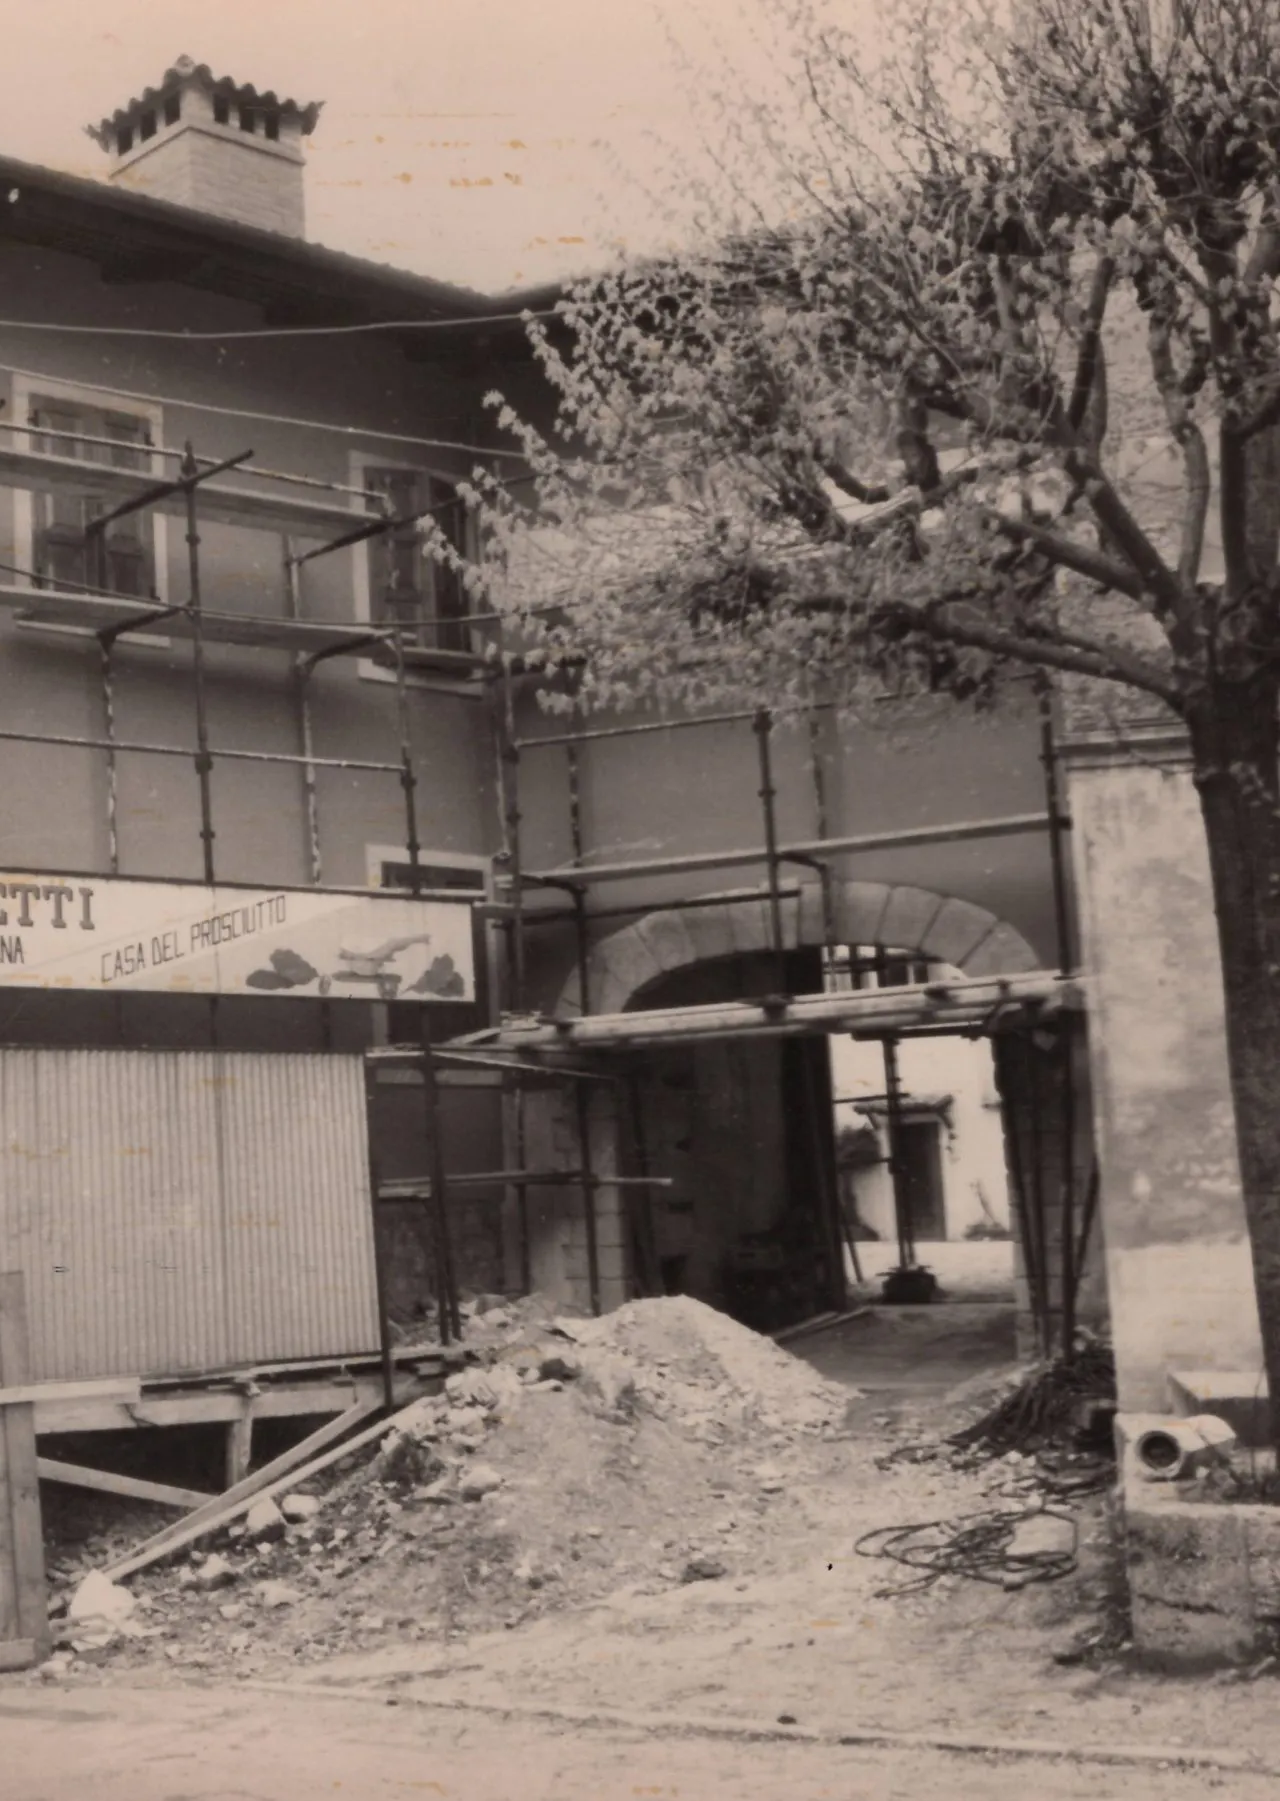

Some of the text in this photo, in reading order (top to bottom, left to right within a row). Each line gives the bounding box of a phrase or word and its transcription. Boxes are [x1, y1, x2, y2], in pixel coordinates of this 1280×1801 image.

[101, 894, 287, 983] CASA DEL PROSCIUTTO
